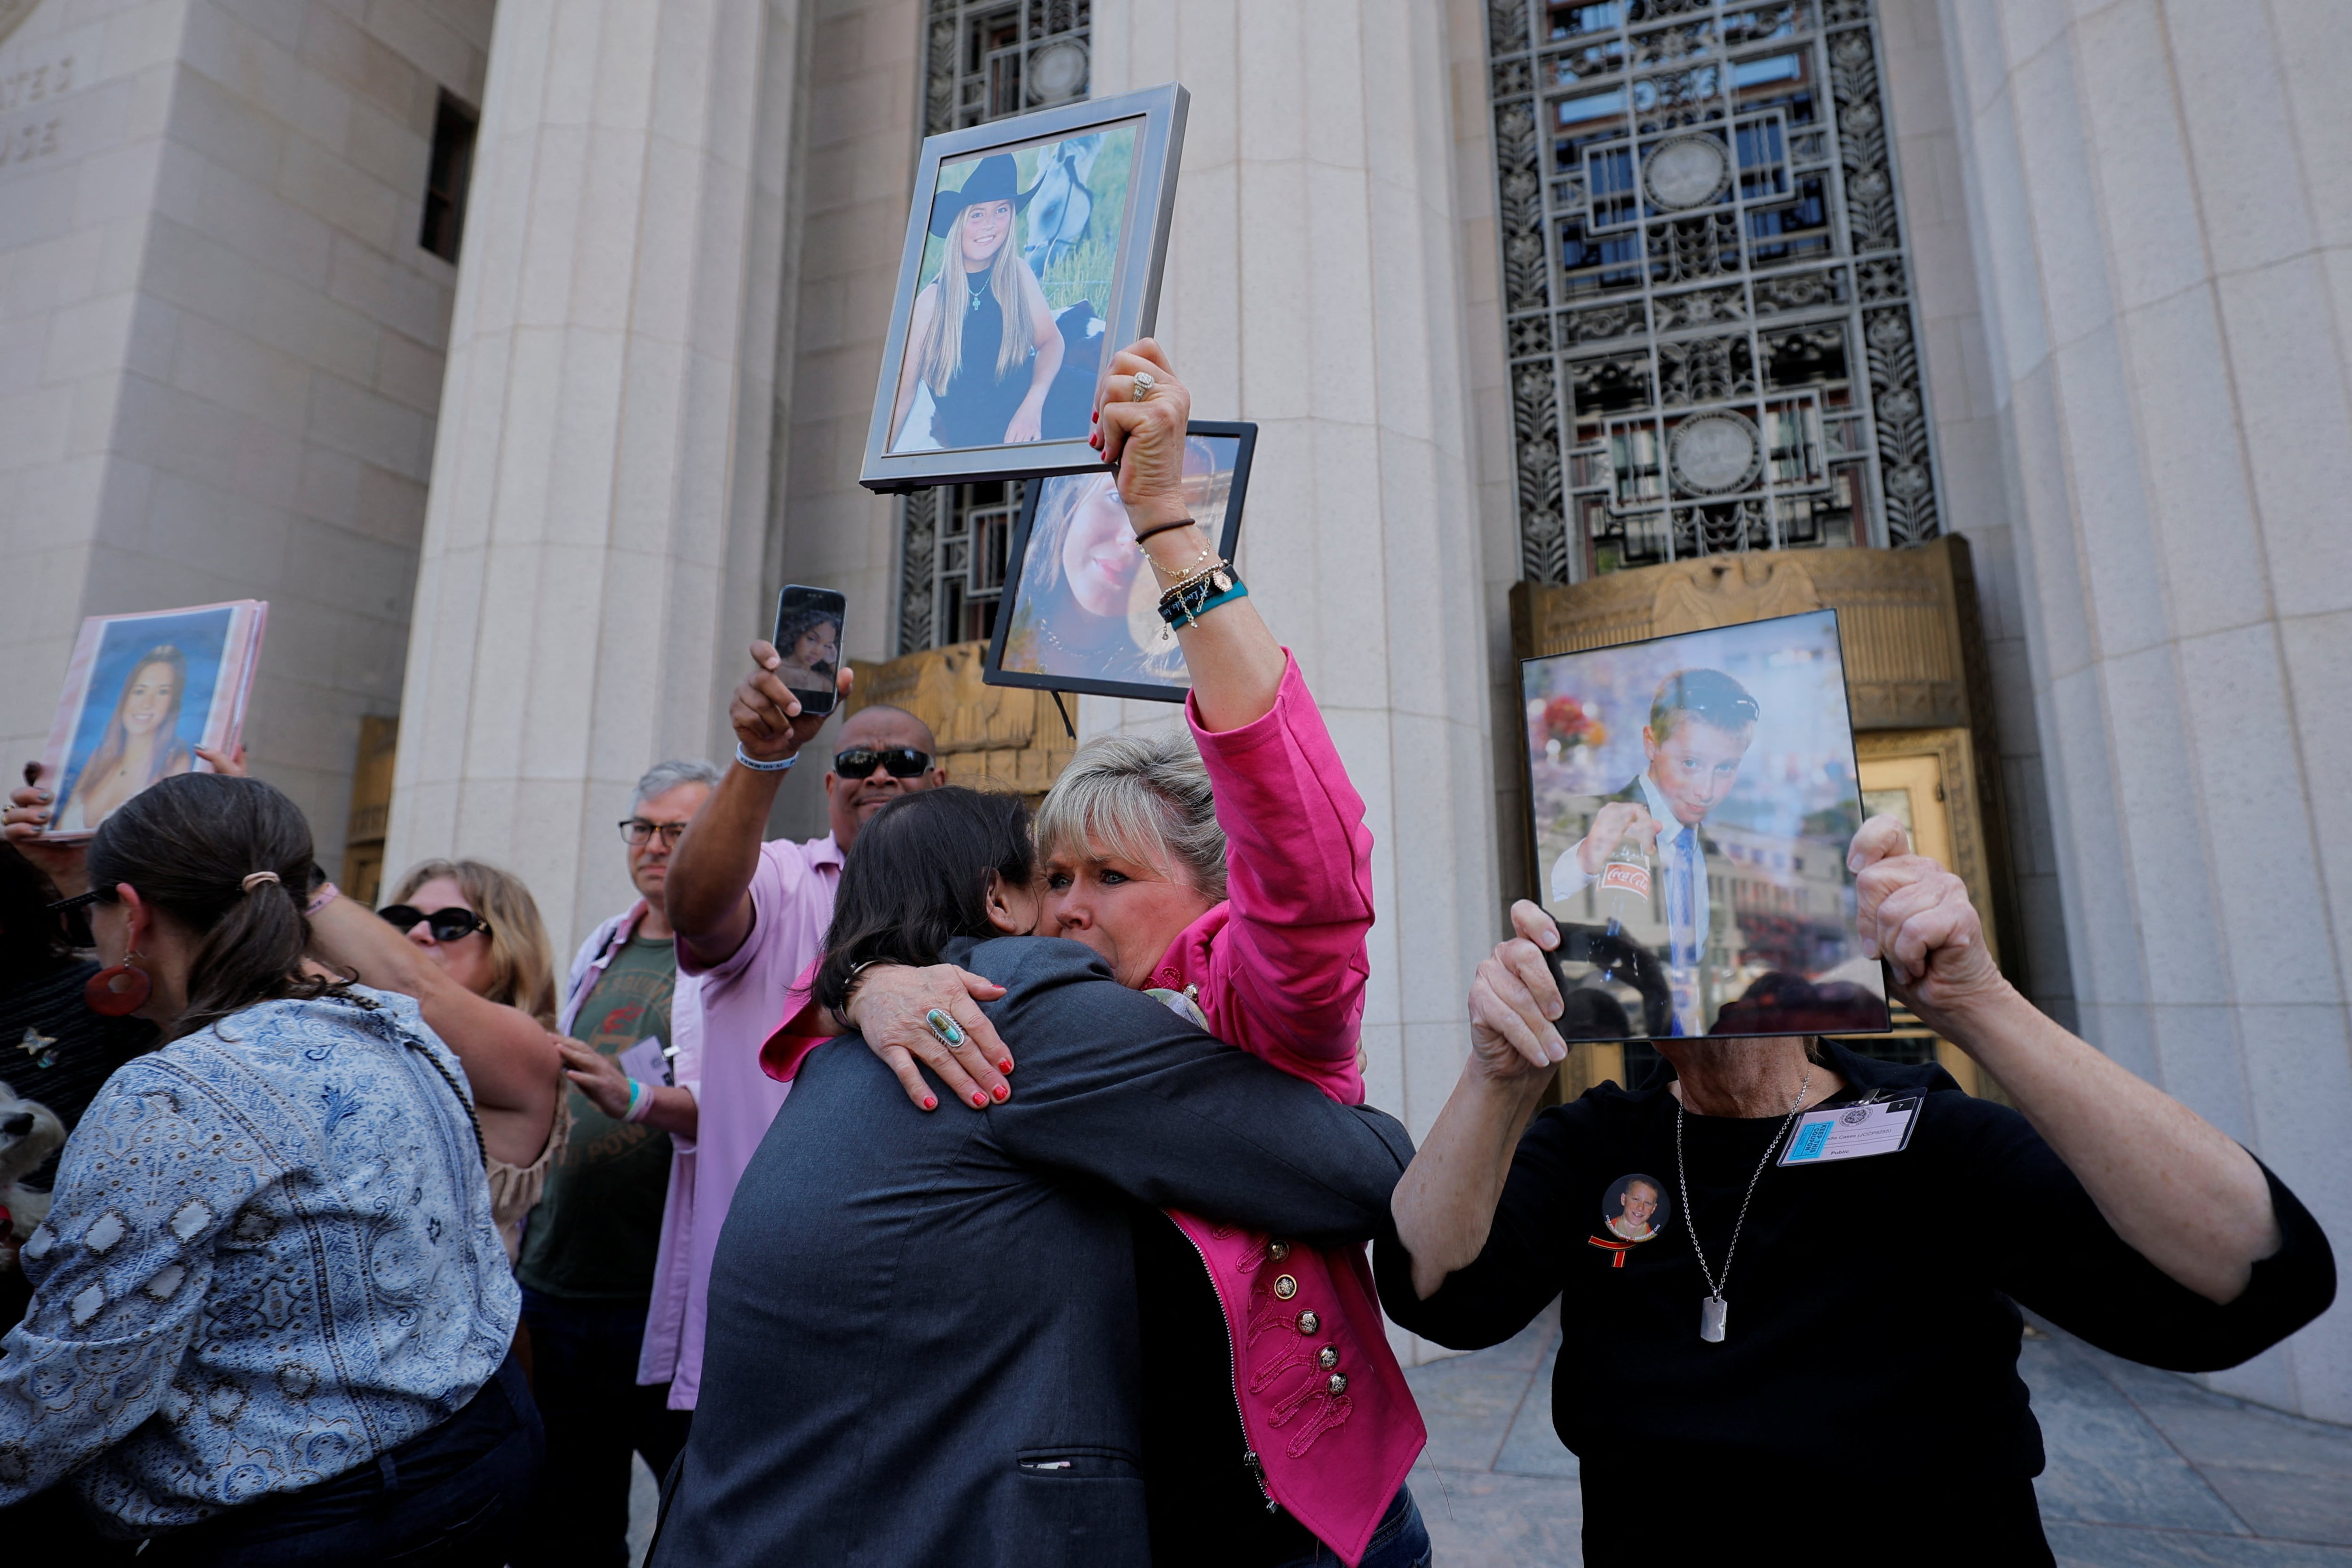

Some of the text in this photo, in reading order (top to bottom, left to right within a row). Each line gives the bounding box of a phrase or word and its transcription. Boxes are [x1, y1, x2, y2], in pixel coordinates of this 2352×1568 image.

[1805, 1128, 1820, 1151] COUPON
[1810, 1124, 1828, 1153] KEEP THIS
